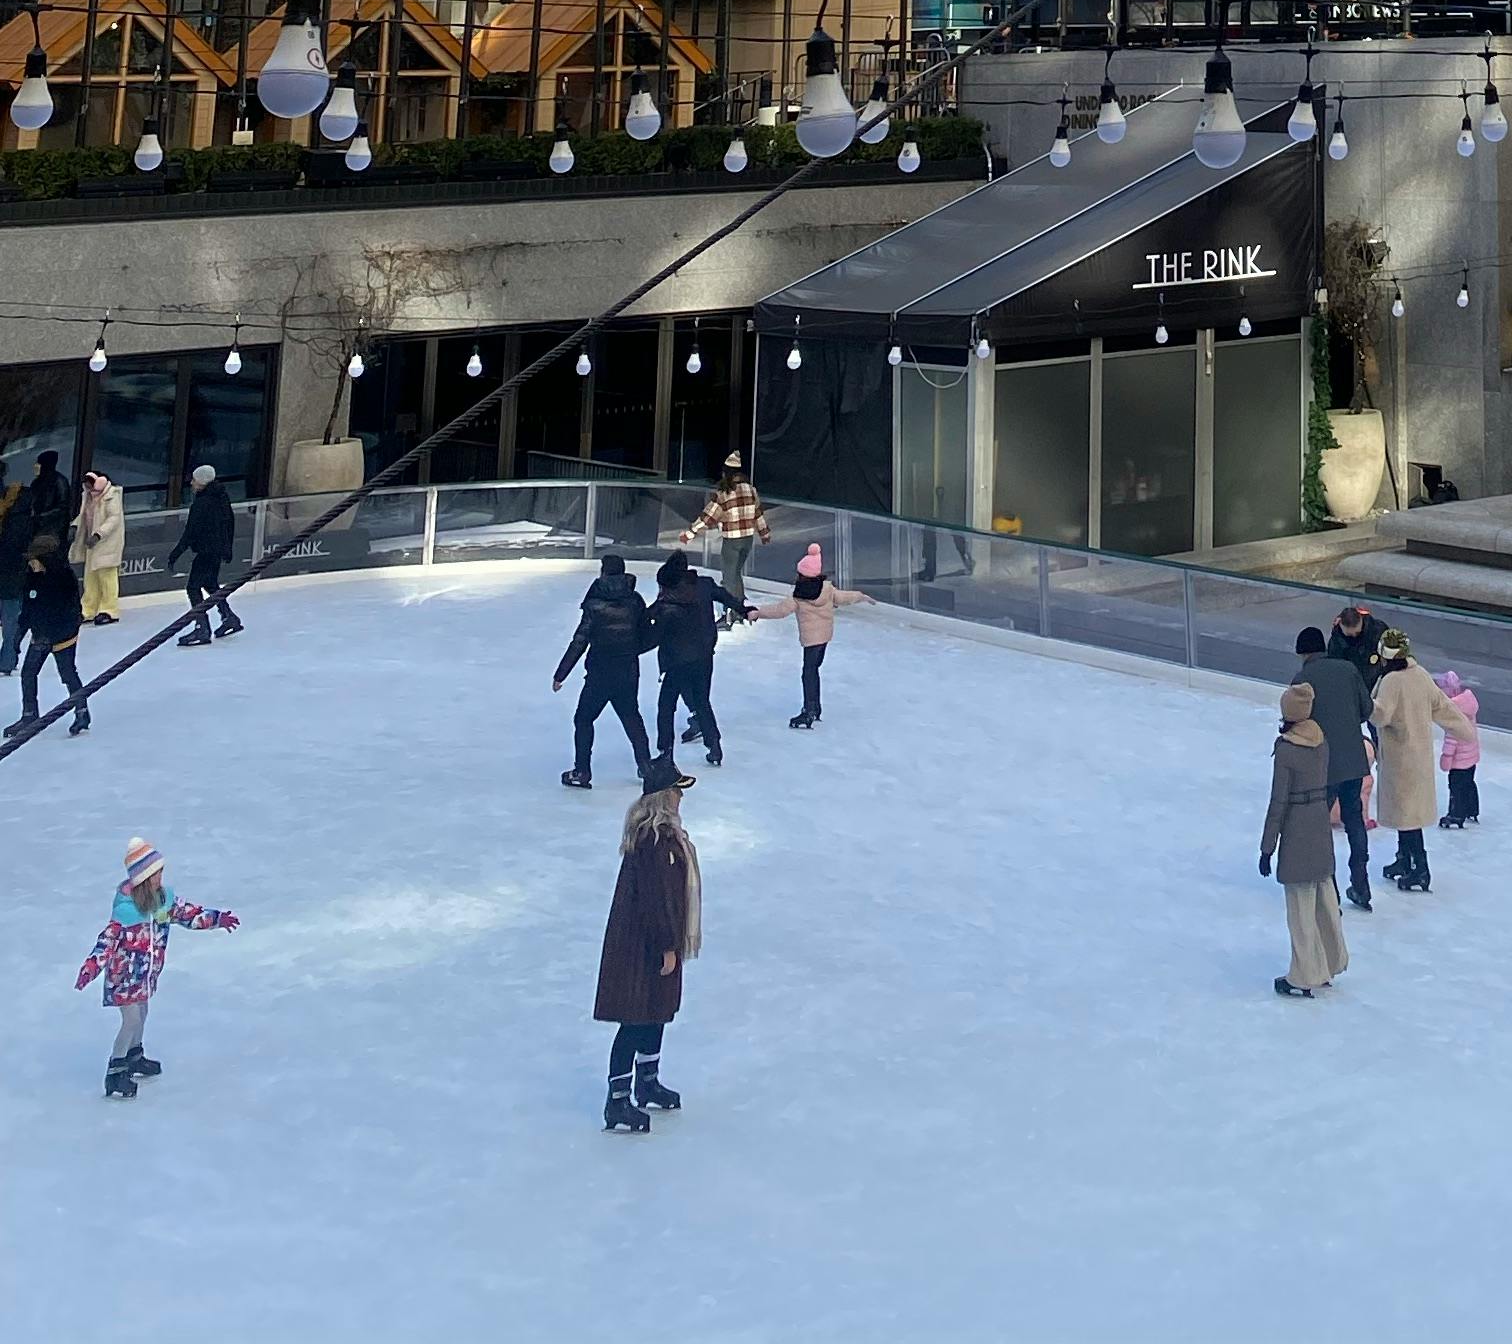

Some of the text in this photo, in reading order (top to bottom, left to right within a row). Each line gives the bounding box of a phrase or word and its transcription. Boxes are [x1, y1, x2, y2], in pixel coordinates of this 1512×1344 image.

[1146, 244, 1262, 285] THE RINK
[121, 556, 156, 575] RINK
